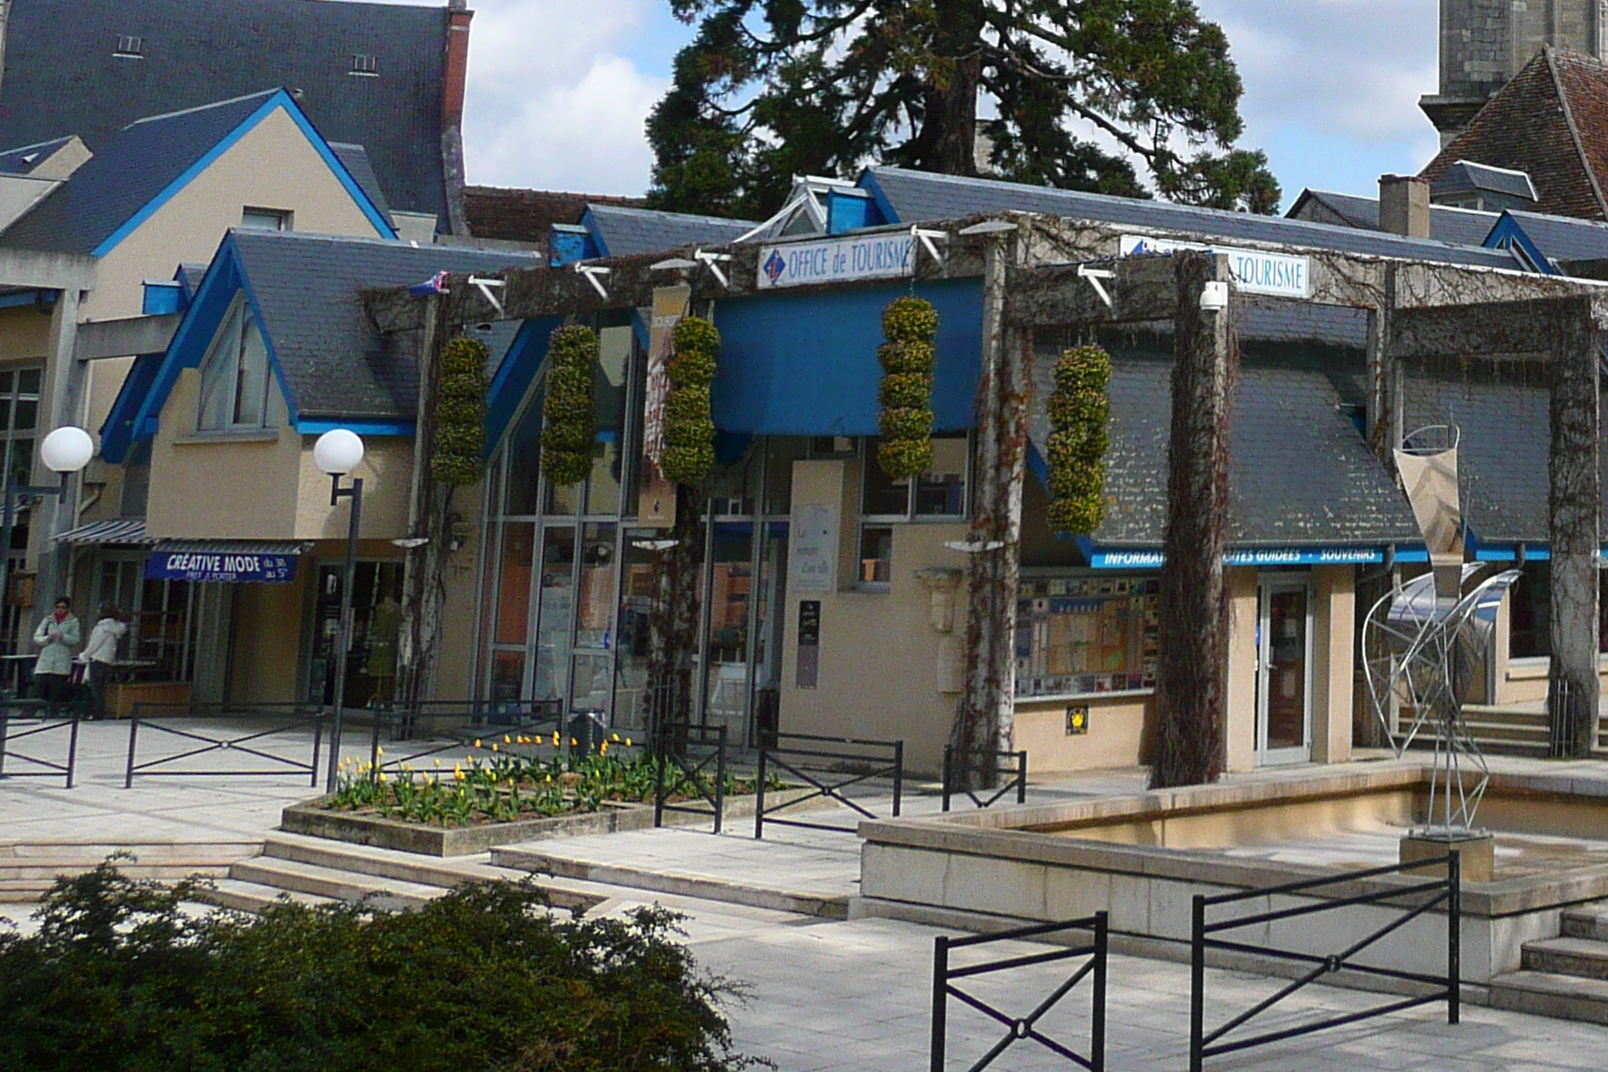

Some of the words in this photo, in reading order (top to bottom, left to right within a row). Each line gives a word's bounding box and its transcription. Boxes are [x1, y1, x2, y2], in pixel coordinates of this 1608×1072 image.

[788, 247, 828, 279] OFFICE
[833, 244, 846, 274] de
[852, 239, 911, 272] TOURISME
[1236, 256, 1303, 290] TOURISME
[166, 553, 221, 572] CRÉATIVE
[224, 556, 261, 573] MODE
[1320, 548, 1376, 561] SOUVENIRS
